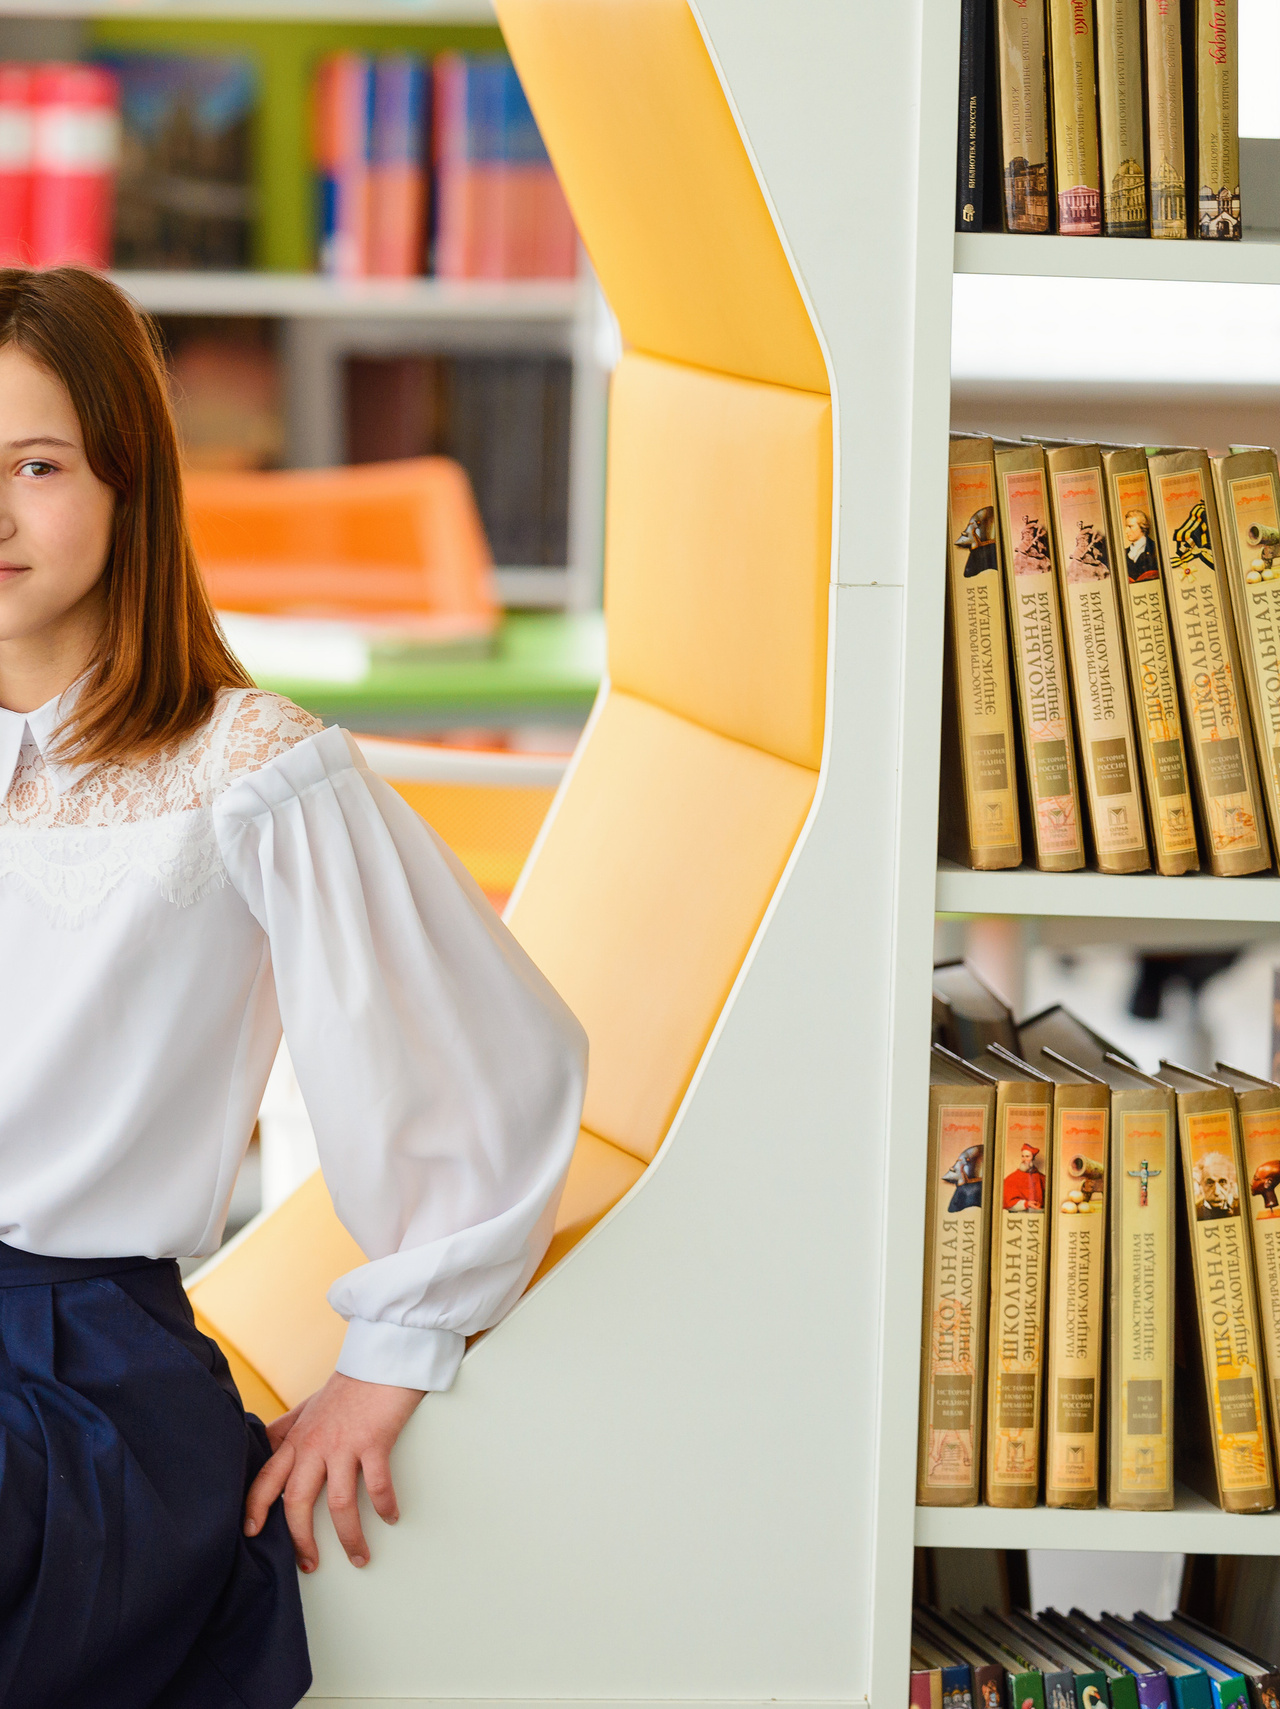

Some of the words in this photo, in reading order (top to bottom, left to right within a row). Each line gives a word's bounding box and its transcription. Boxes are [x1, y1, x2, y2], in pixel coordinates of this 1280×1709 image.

[1020, 17, 1030, 61] БОЛЬШАЯ
[1116, 10, 1125, 87] ЭНЦИКЛОПЕДИЯ
[1166, 24, 1176, 68] БОЛЬШАЯ
[1208, 10, 1227, 64] галерея
[968, 140, 976, 189] БИБЛИОТЕКА
[969, 95, 977, 140] ИСКУССТВА
[1011, 86, 1021, 144] ЖИВОПИСИ
[1022, 65, 1032, 144] ЭНЦИКЛОПЕДИЯ
[1065, 124, 1074, 176] ЖИВОПИСИ
[1075, 105, 1086, 176] ЭНЦИКЛОПЕДИЯ
[1120, 89, 1128, 148] ЖИВОПИСИ
[1168, 72, 1178, 150] ЭНЦИКЛОПЕДИЯ
[1210, 132, 1218, 184] ЖИВОПИСИ
[1222, 112, 1230, 184] ЭНЦИКЛОПЕДИЯ
[966, 588, 982, 716] ИЛЛЮСТРИРОВАННАЯ
[976, 586, 997, 716] ЭНЦИКЛОПЕДИЯ
[1020, 593, 1048, 722] ШКОЛЬНАЯ
[1038, 592, 1060, 722] ЭНЦИКЛОПЕДИЯ
[1079, 594, 1102, 720] ИЛЛЮСТРИРОВАННАЯ
[1090, 591, 1115, 720] ЭНЦИКЛОПЕДИЯ
[1132, 594, 1163, 722] ШКОЛЬНАЯ
[1148, 592, 1175, 720] ЭНЦИКЛОПЕДИЯ
[1181, 587, 1217, 730] ШКОЛЬНАЯ
[1200, 584, 1234, 726] ЭНЦИКЛОПЕДИЯ
[1038, 764, 1067, 772] РОССИИ
[1096, 754, 1125, 763] ИСТОРИЯ
[1098, 762, 1127, 771] РОССИИ
[938, 1220, 958, 1362] ШКОЛЬНАЯ
[958, 1220, 976, 1363] ЭНЦИКЛОПЕДИЯ
[1002, 1218, 1022, 1360] ШКОЛЬНАЯ
[1023, 1218, 1040, 1362] ЭНЦИКЛОПЕДИЯ
[1066, 1231, 1078, 1358] ИЛЛЮСТРИРОВАННАЯ
[1076, 1230, 1090, 1360] ЭНЦИКЛОПЕДИЯ
[1132, 1234, 1142, 1360] ИЛЛЮСТРИРОВАННАЯ
[1143, 1232, 1158, 1361] ЭНЦИКЛОПЕДИЯ
[1204, 1225, 1232, 1367] ШКОЛЬНАЯ
[1224, 1223, 1250, 1366] ЭНЦИКЛОПЕДИЯ
